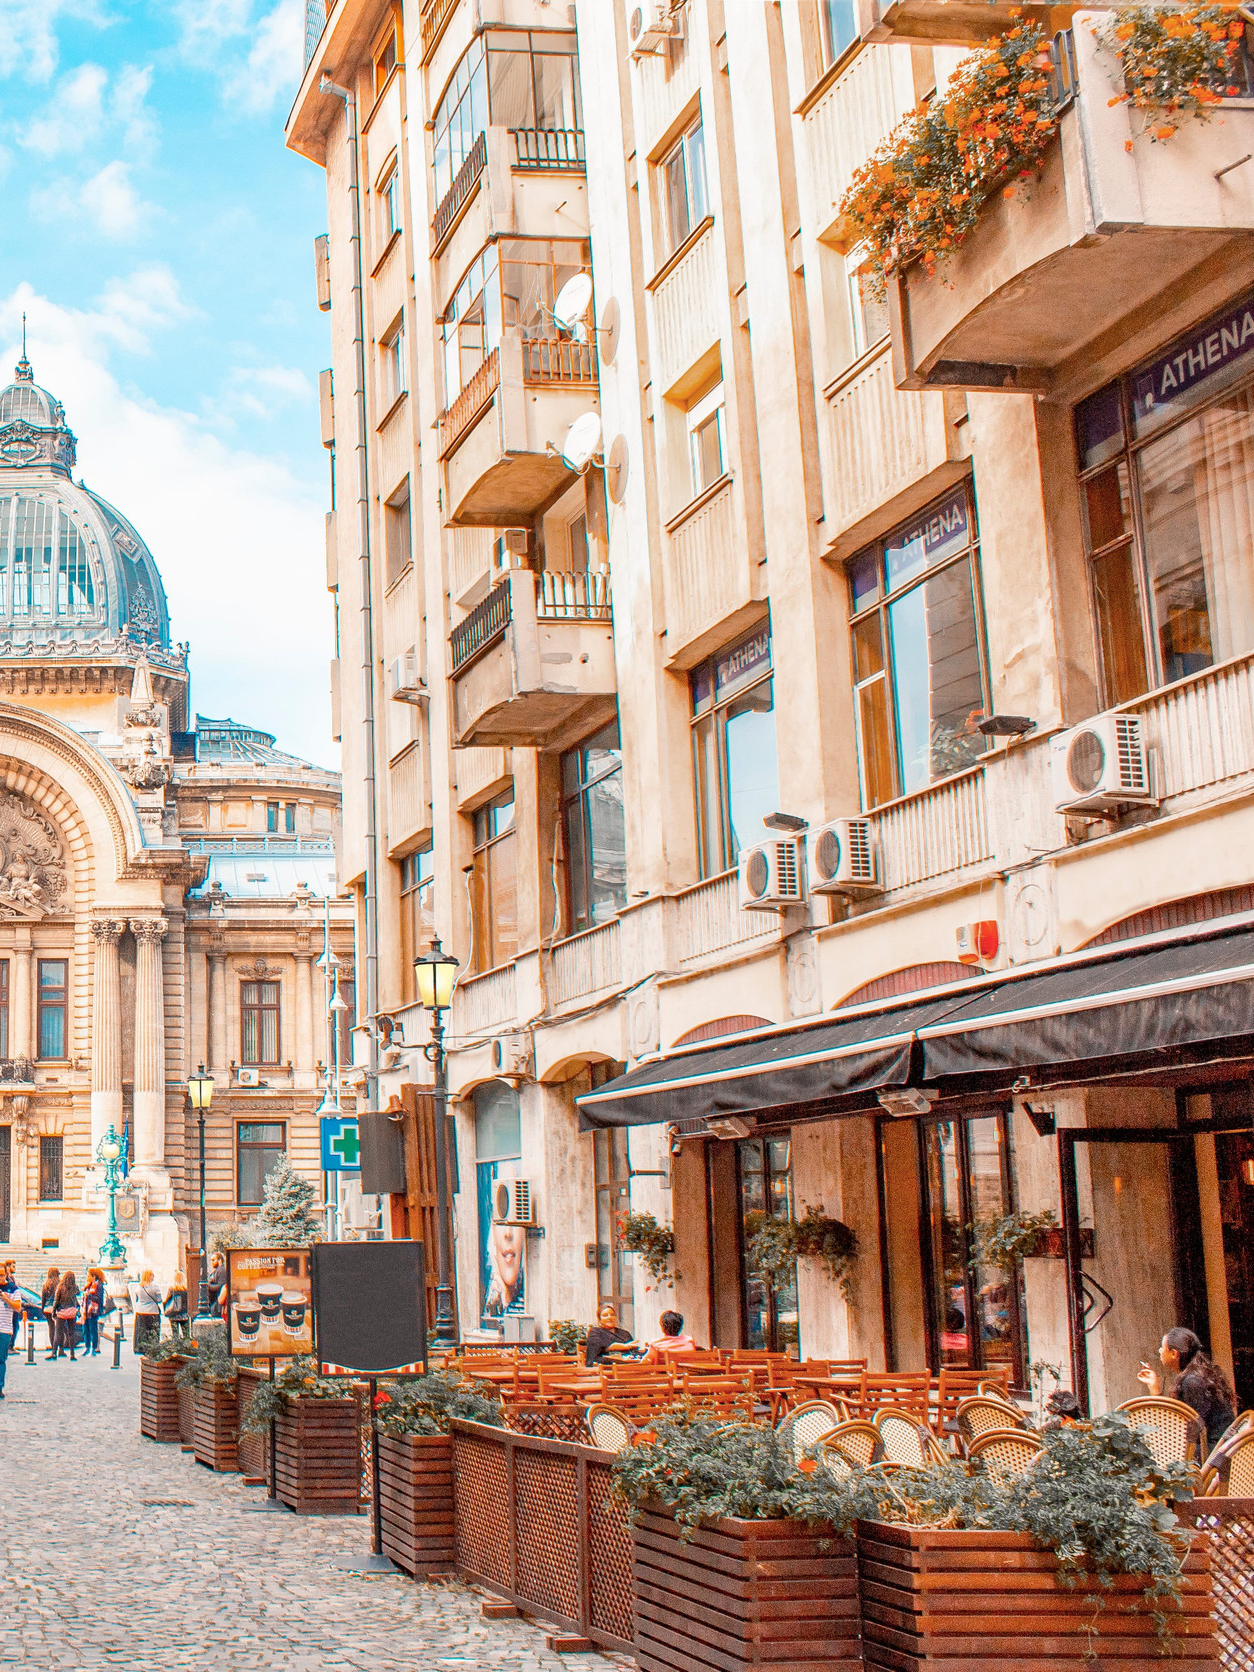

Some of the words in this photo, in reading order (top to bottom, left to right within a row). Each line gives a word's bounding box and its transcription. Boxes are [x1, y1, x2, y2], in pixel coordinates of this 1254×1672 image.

[1159, 311, 1254, 396] ATHENA
[902, 503, 964, 562] ATHENA
[728, 632, 769, 676] ATHENA
[244, 1257, 272, 1265] PASSION
